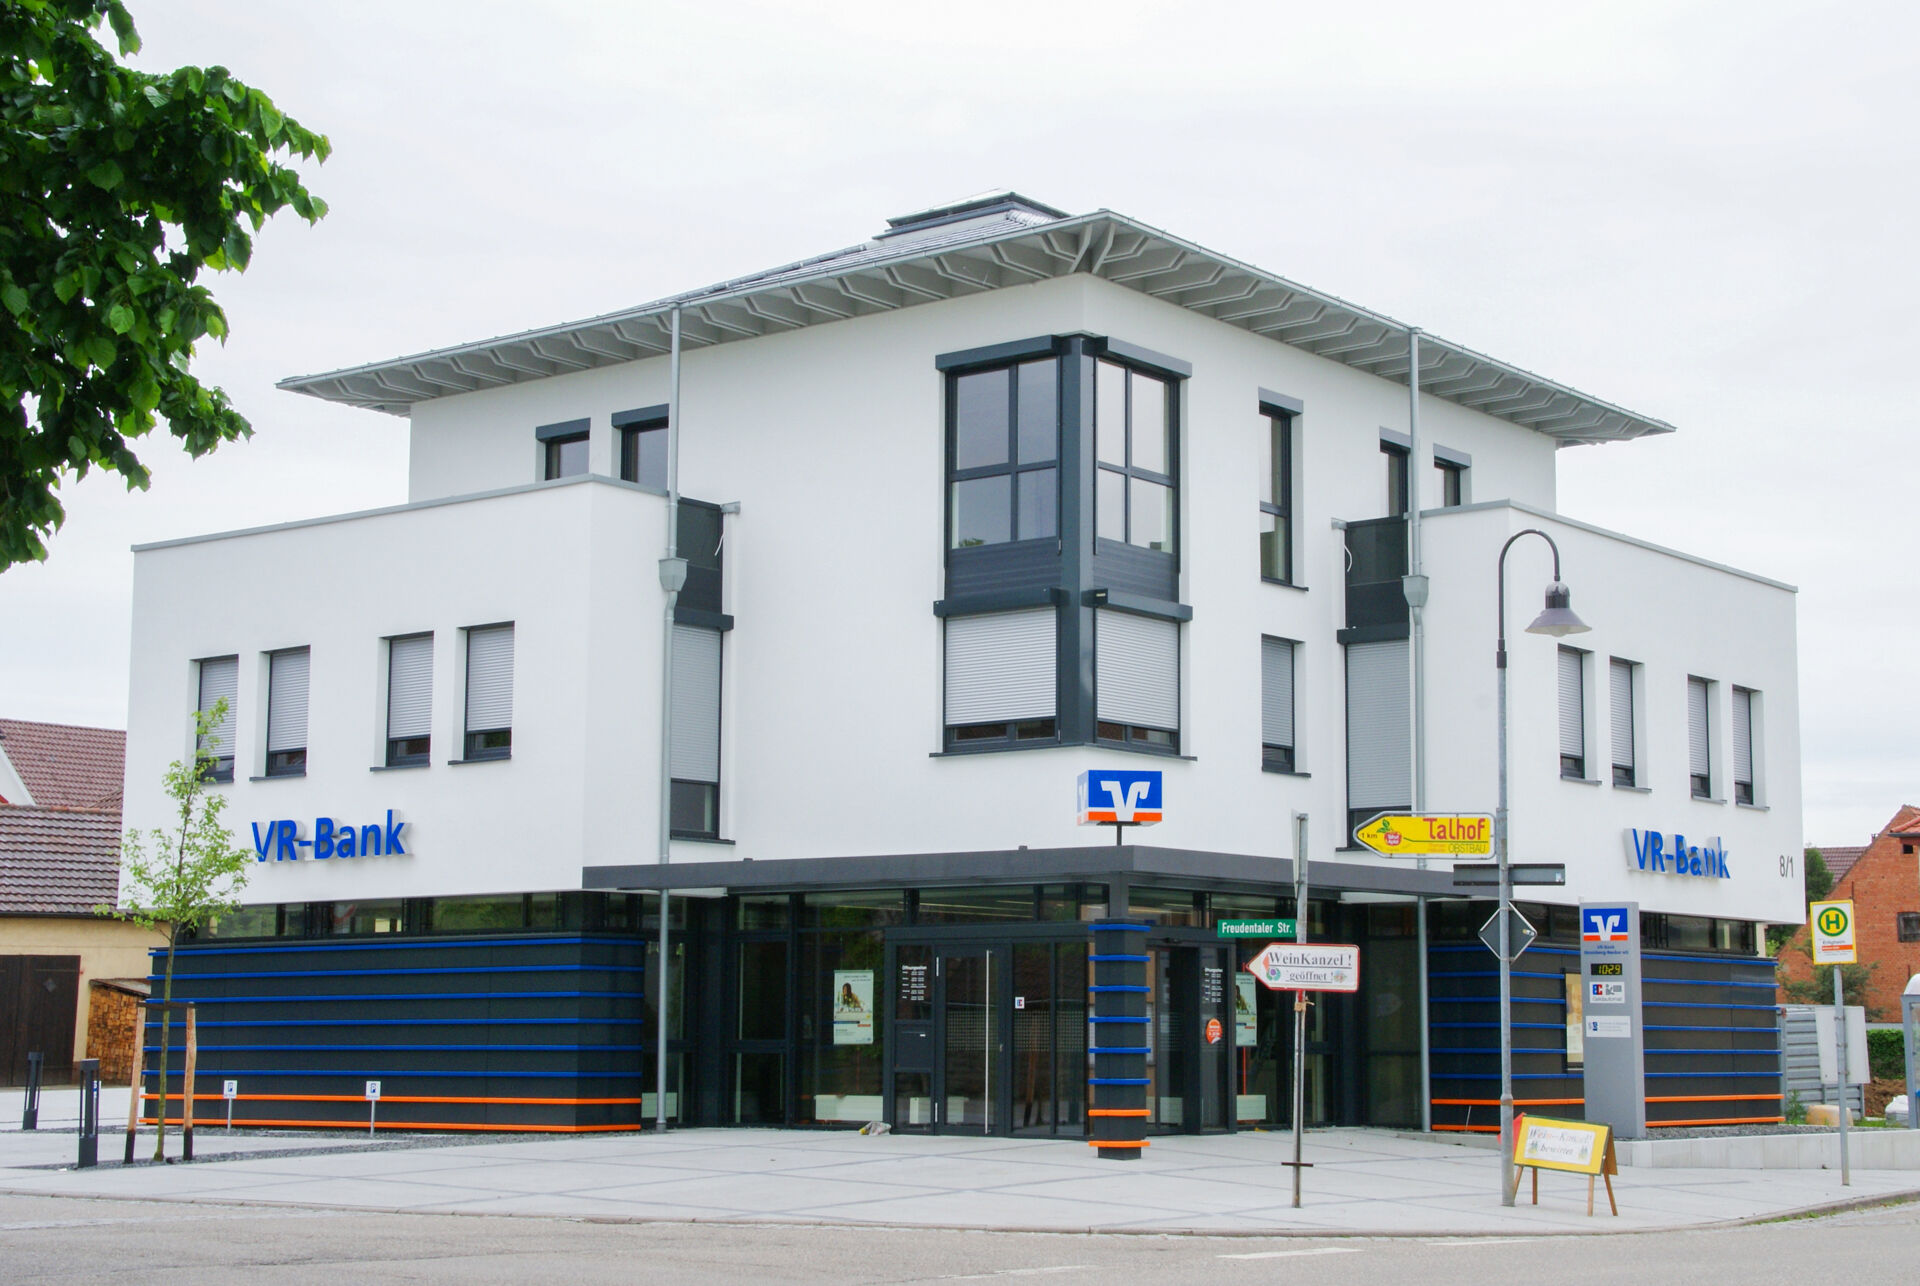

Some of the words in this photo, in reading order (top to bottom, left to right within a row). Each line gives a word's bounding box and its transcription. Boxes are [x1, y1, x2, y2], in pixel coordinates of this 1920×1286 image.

[251, 809, 405, 862] VR-Bank
[1423, 818, 1486, 840] Talhof
[1448, 843, 1486, 853] OBSTBAU
[1632, 828, 1731, 879] VR-Bank
[1779, 855, 1794, 878] 8/1
[1221, 922, 1273, 933] Freudentaler
[1277, 922, 1293, 934] Str.
